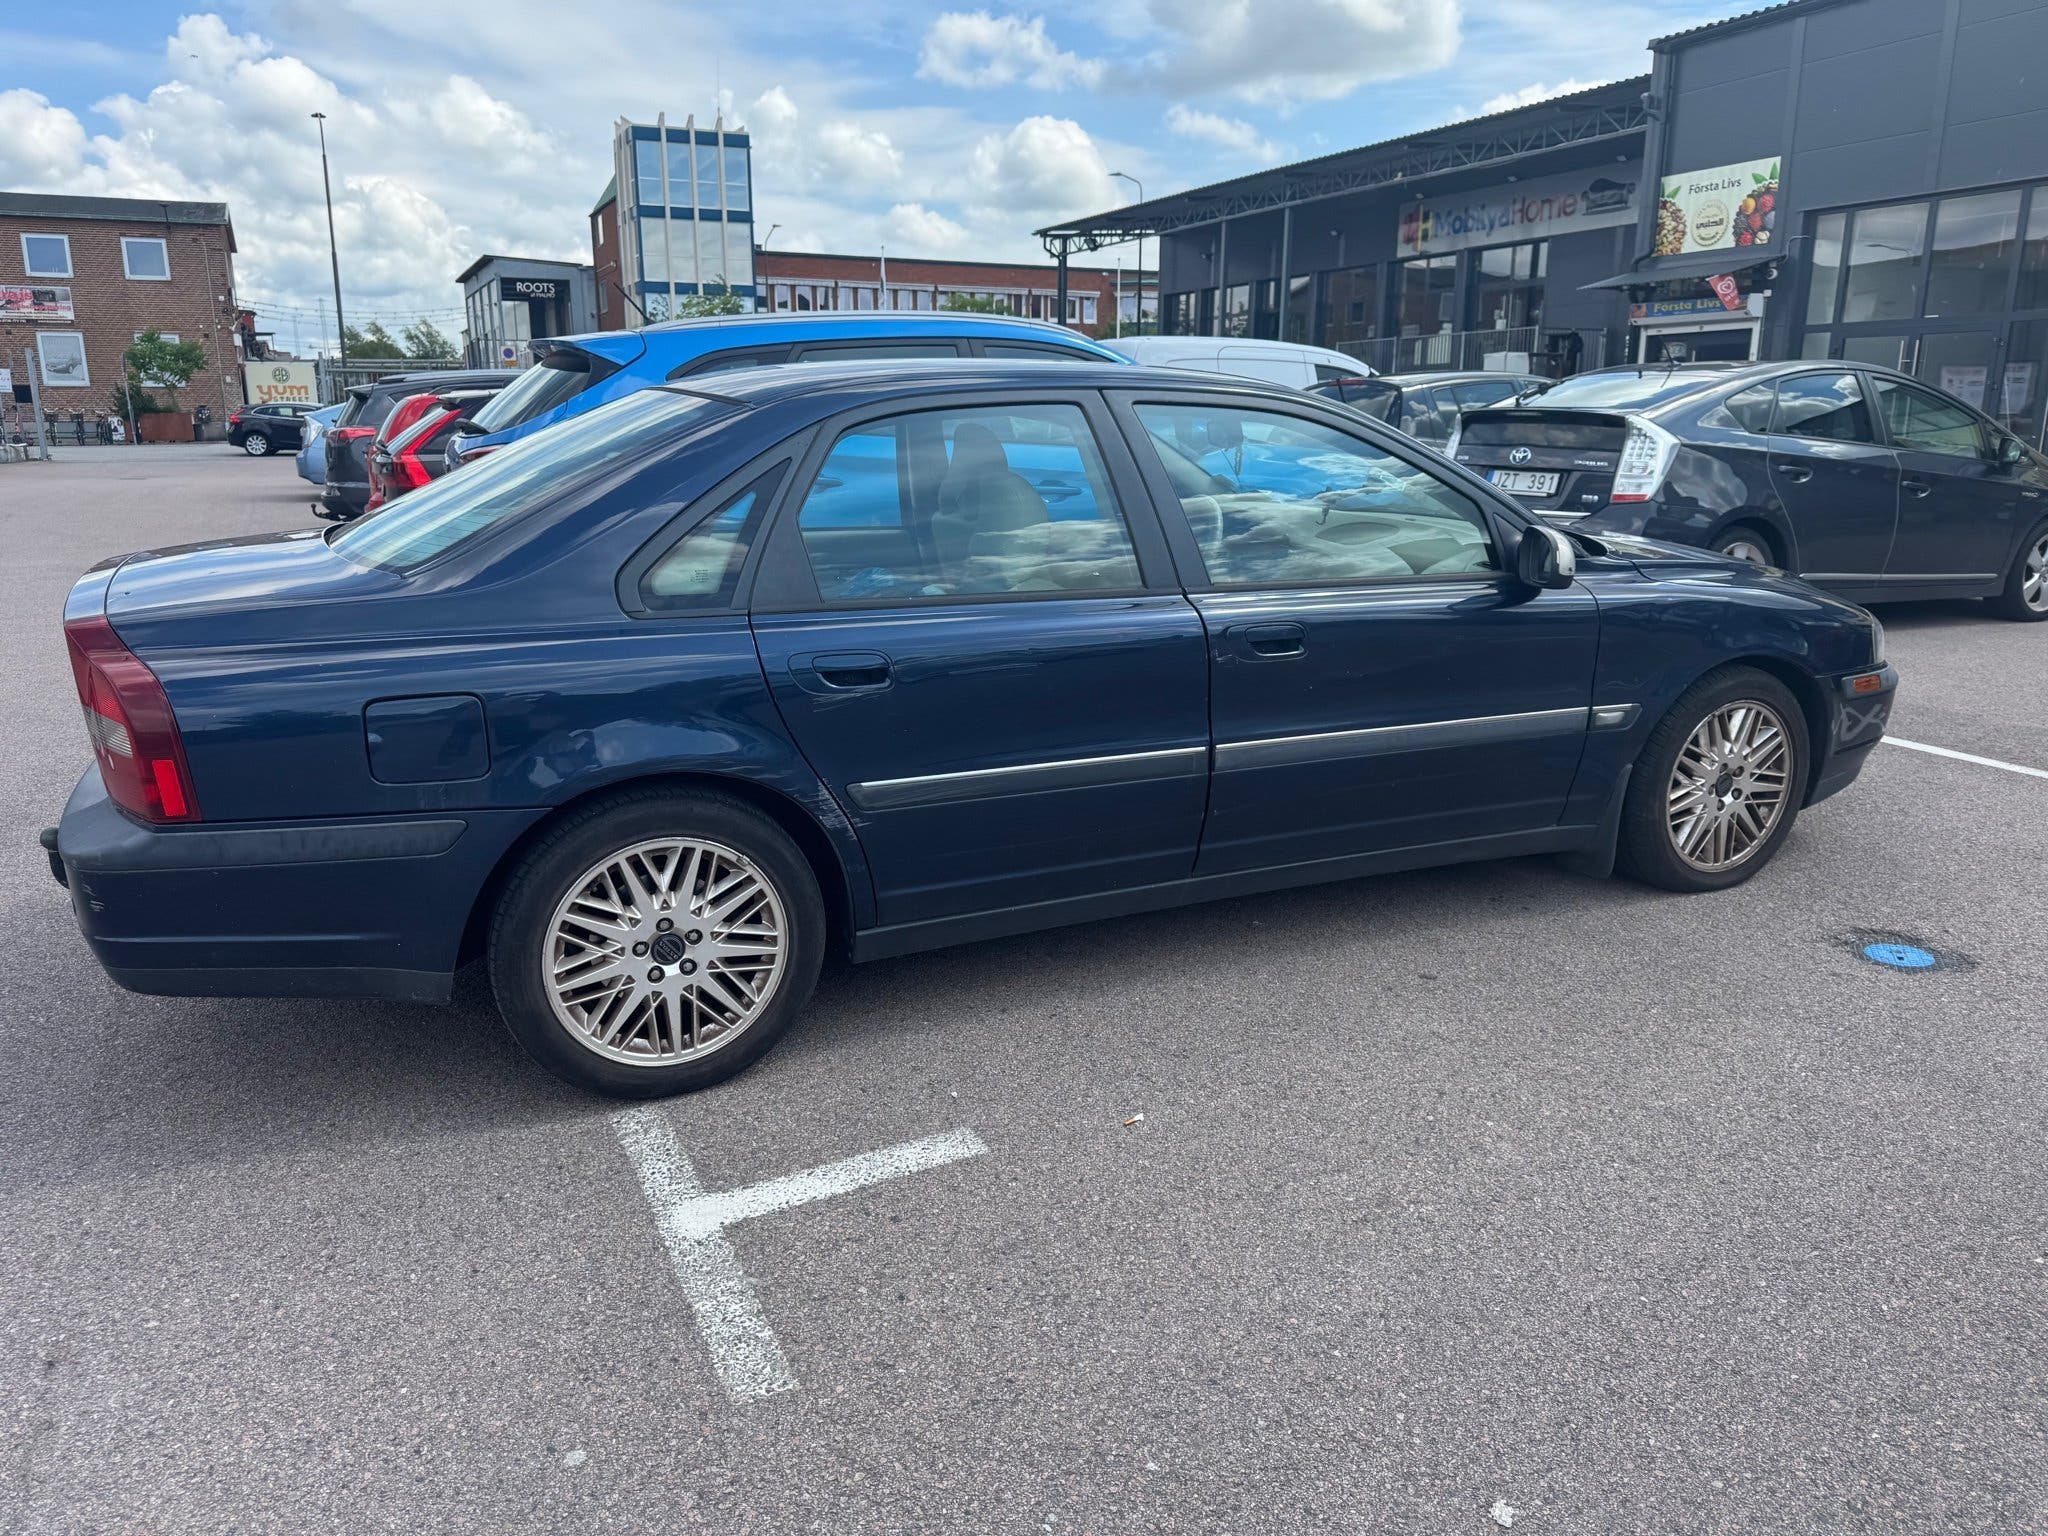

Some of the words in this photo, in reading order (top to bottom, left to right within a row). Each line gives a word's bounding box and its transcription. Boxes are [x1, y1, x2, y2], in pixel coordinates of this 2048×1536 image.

[1689, 183, 1720, 195] Första
[1721, 178, 1742, 190] Livs
[516, 281, 556, 293] ROOTS
[1493, 469, 1520, 489] JZT
[1527, 473, 1555, 491] 391
